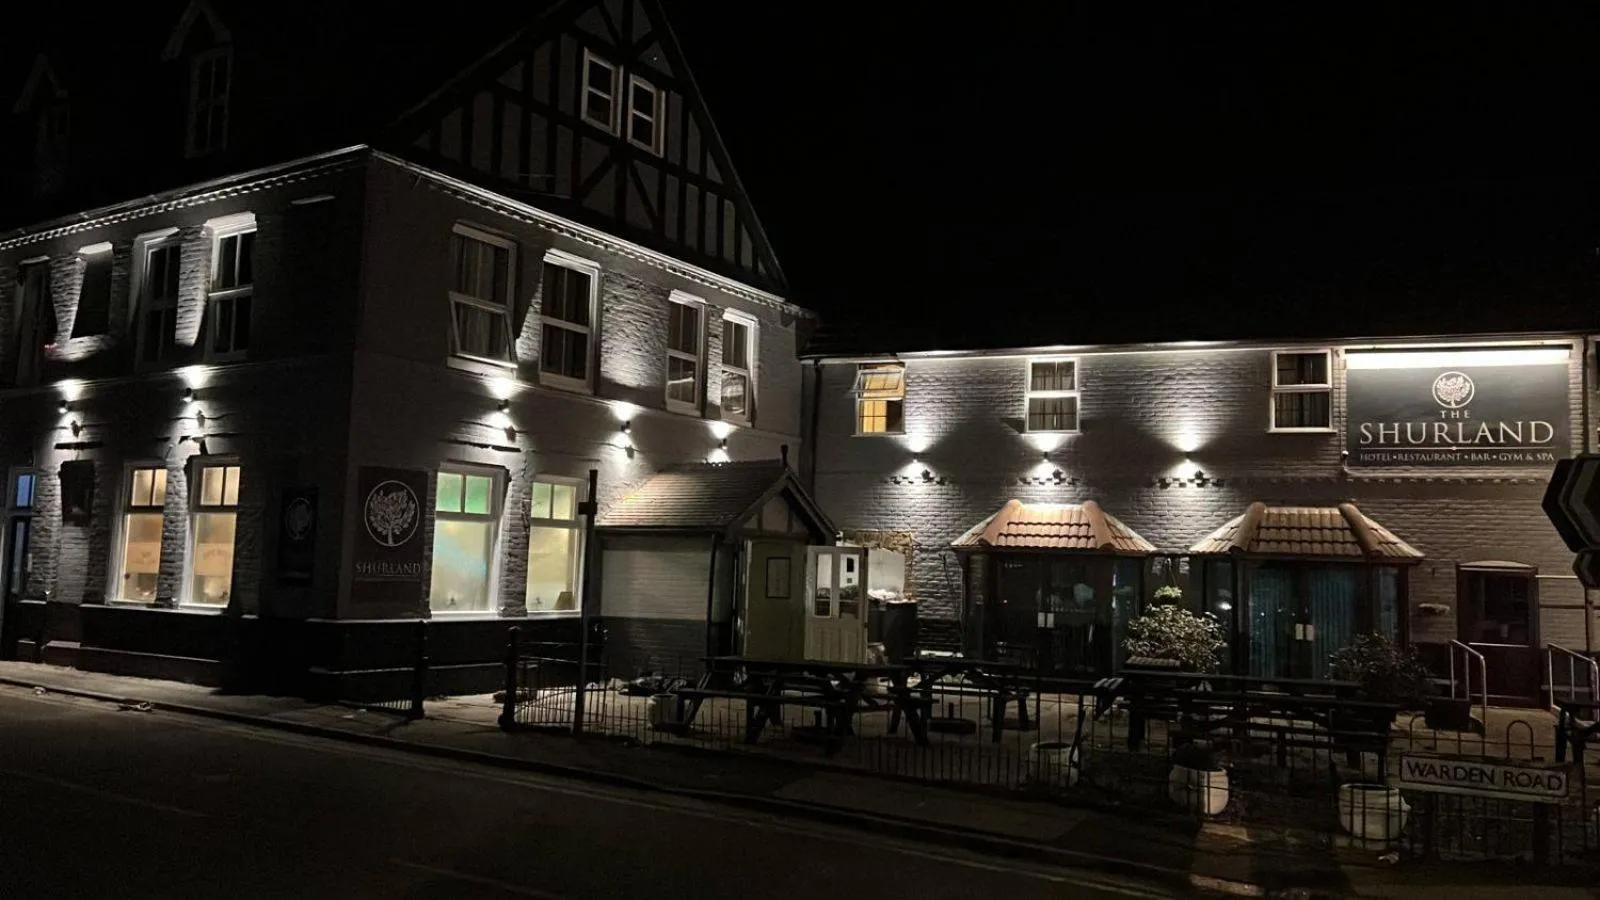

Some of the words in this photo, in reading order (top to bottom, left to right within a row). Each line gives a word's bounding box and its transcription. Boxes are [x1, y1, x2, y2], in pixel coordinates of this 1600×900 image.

[1440, 409, 1471, 419] THE
[1359, 420, 1554, 445] SHURLAND
[1360, 452, 1391, 462] HOTEL
[1398, 452, 1461, 462] RESTAURANT
[1471, 452, 1491, 461] BAR
[1499, 452, 1523, 461] GYM
[1525, 452, 1534, 461] &
[1536, 452, 1555, 461] SPA
[355, 560, 421, 574] SHURLAND
[1407, 762, 1495, 785] WARDEN
[1503, 770, 1563, 792] ROAD
